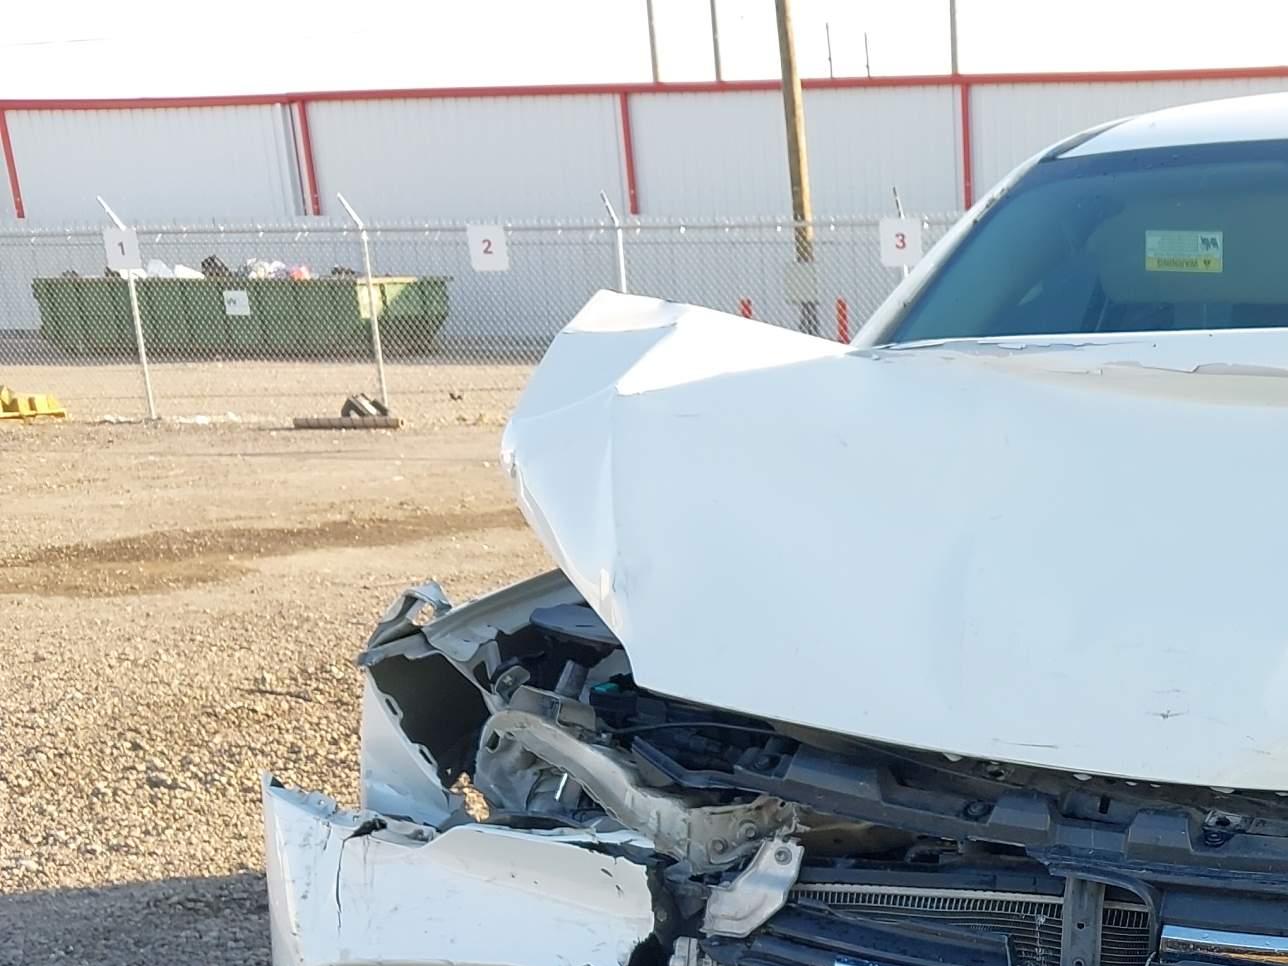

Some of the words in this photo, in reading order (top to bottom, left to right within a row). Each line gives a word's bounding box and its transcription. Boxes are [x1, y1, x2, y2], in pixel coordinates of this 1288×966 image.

[117, 241, 125, 256] 1
[482, 239, 493, 254] 2
[895, 233, 906, 249] 3
